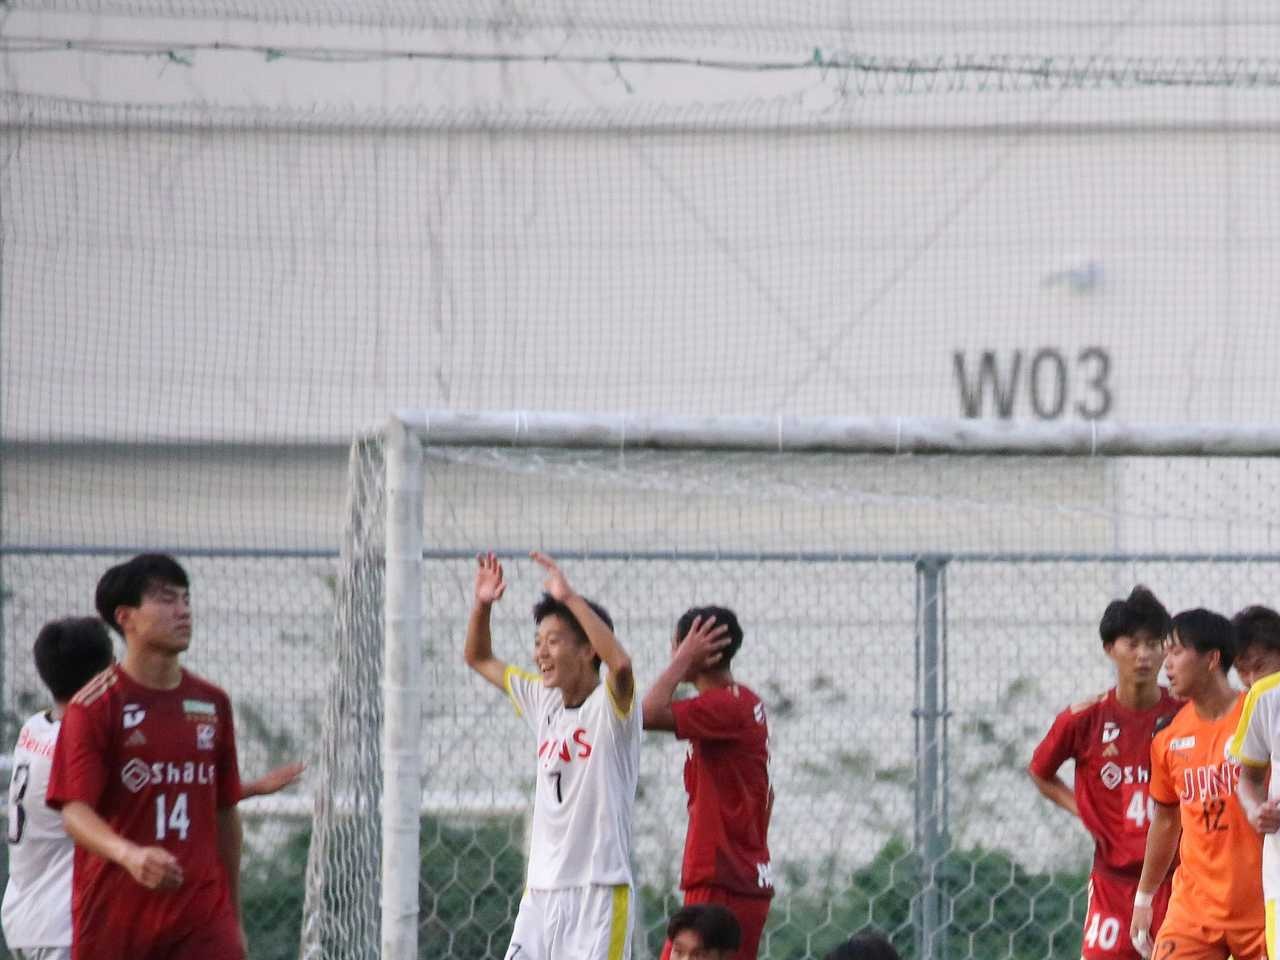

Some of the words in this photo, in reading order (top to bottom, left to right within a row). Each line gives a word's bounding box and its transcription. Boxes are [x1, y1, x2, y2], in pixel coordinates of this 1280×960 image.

[953, 347, 1112, 419] W03
[549, 772, 562, 804] 7
[155, 793, 191, 841] 14
[1203, 801, 1229, 832] 12
[1084, 913, 1120, 951] 40
